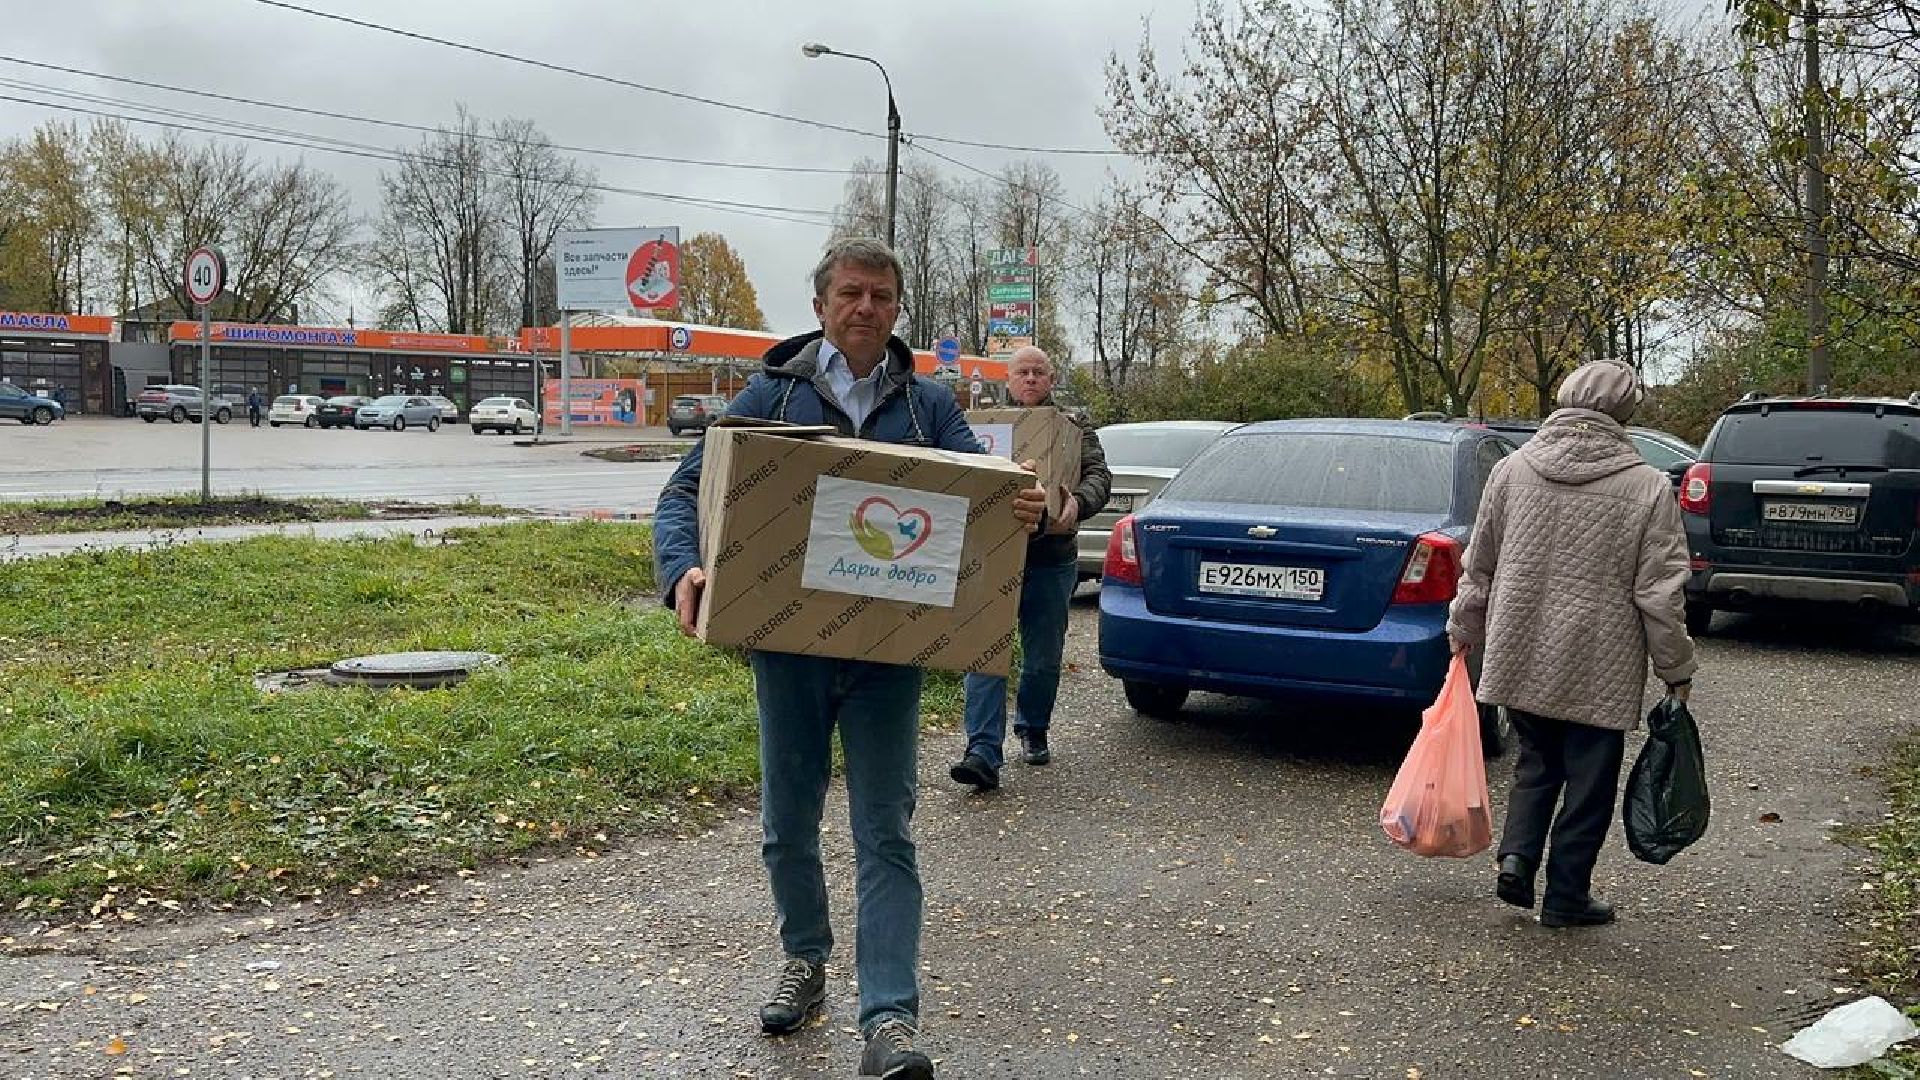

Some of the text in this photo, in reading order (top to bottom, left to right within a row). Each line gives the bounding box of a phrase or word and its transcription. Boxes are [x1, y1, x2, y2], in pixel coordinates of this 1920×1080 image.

[194, 265, 211, 286] 40
[0, 314, 68, 331] МАСЛА
[225, 326, 357, 346] ШИНОМОНТАЖ
[829, 556, 937, 588] Дари добро
[1206, 565, 1319, 589] Е926МХ 150
